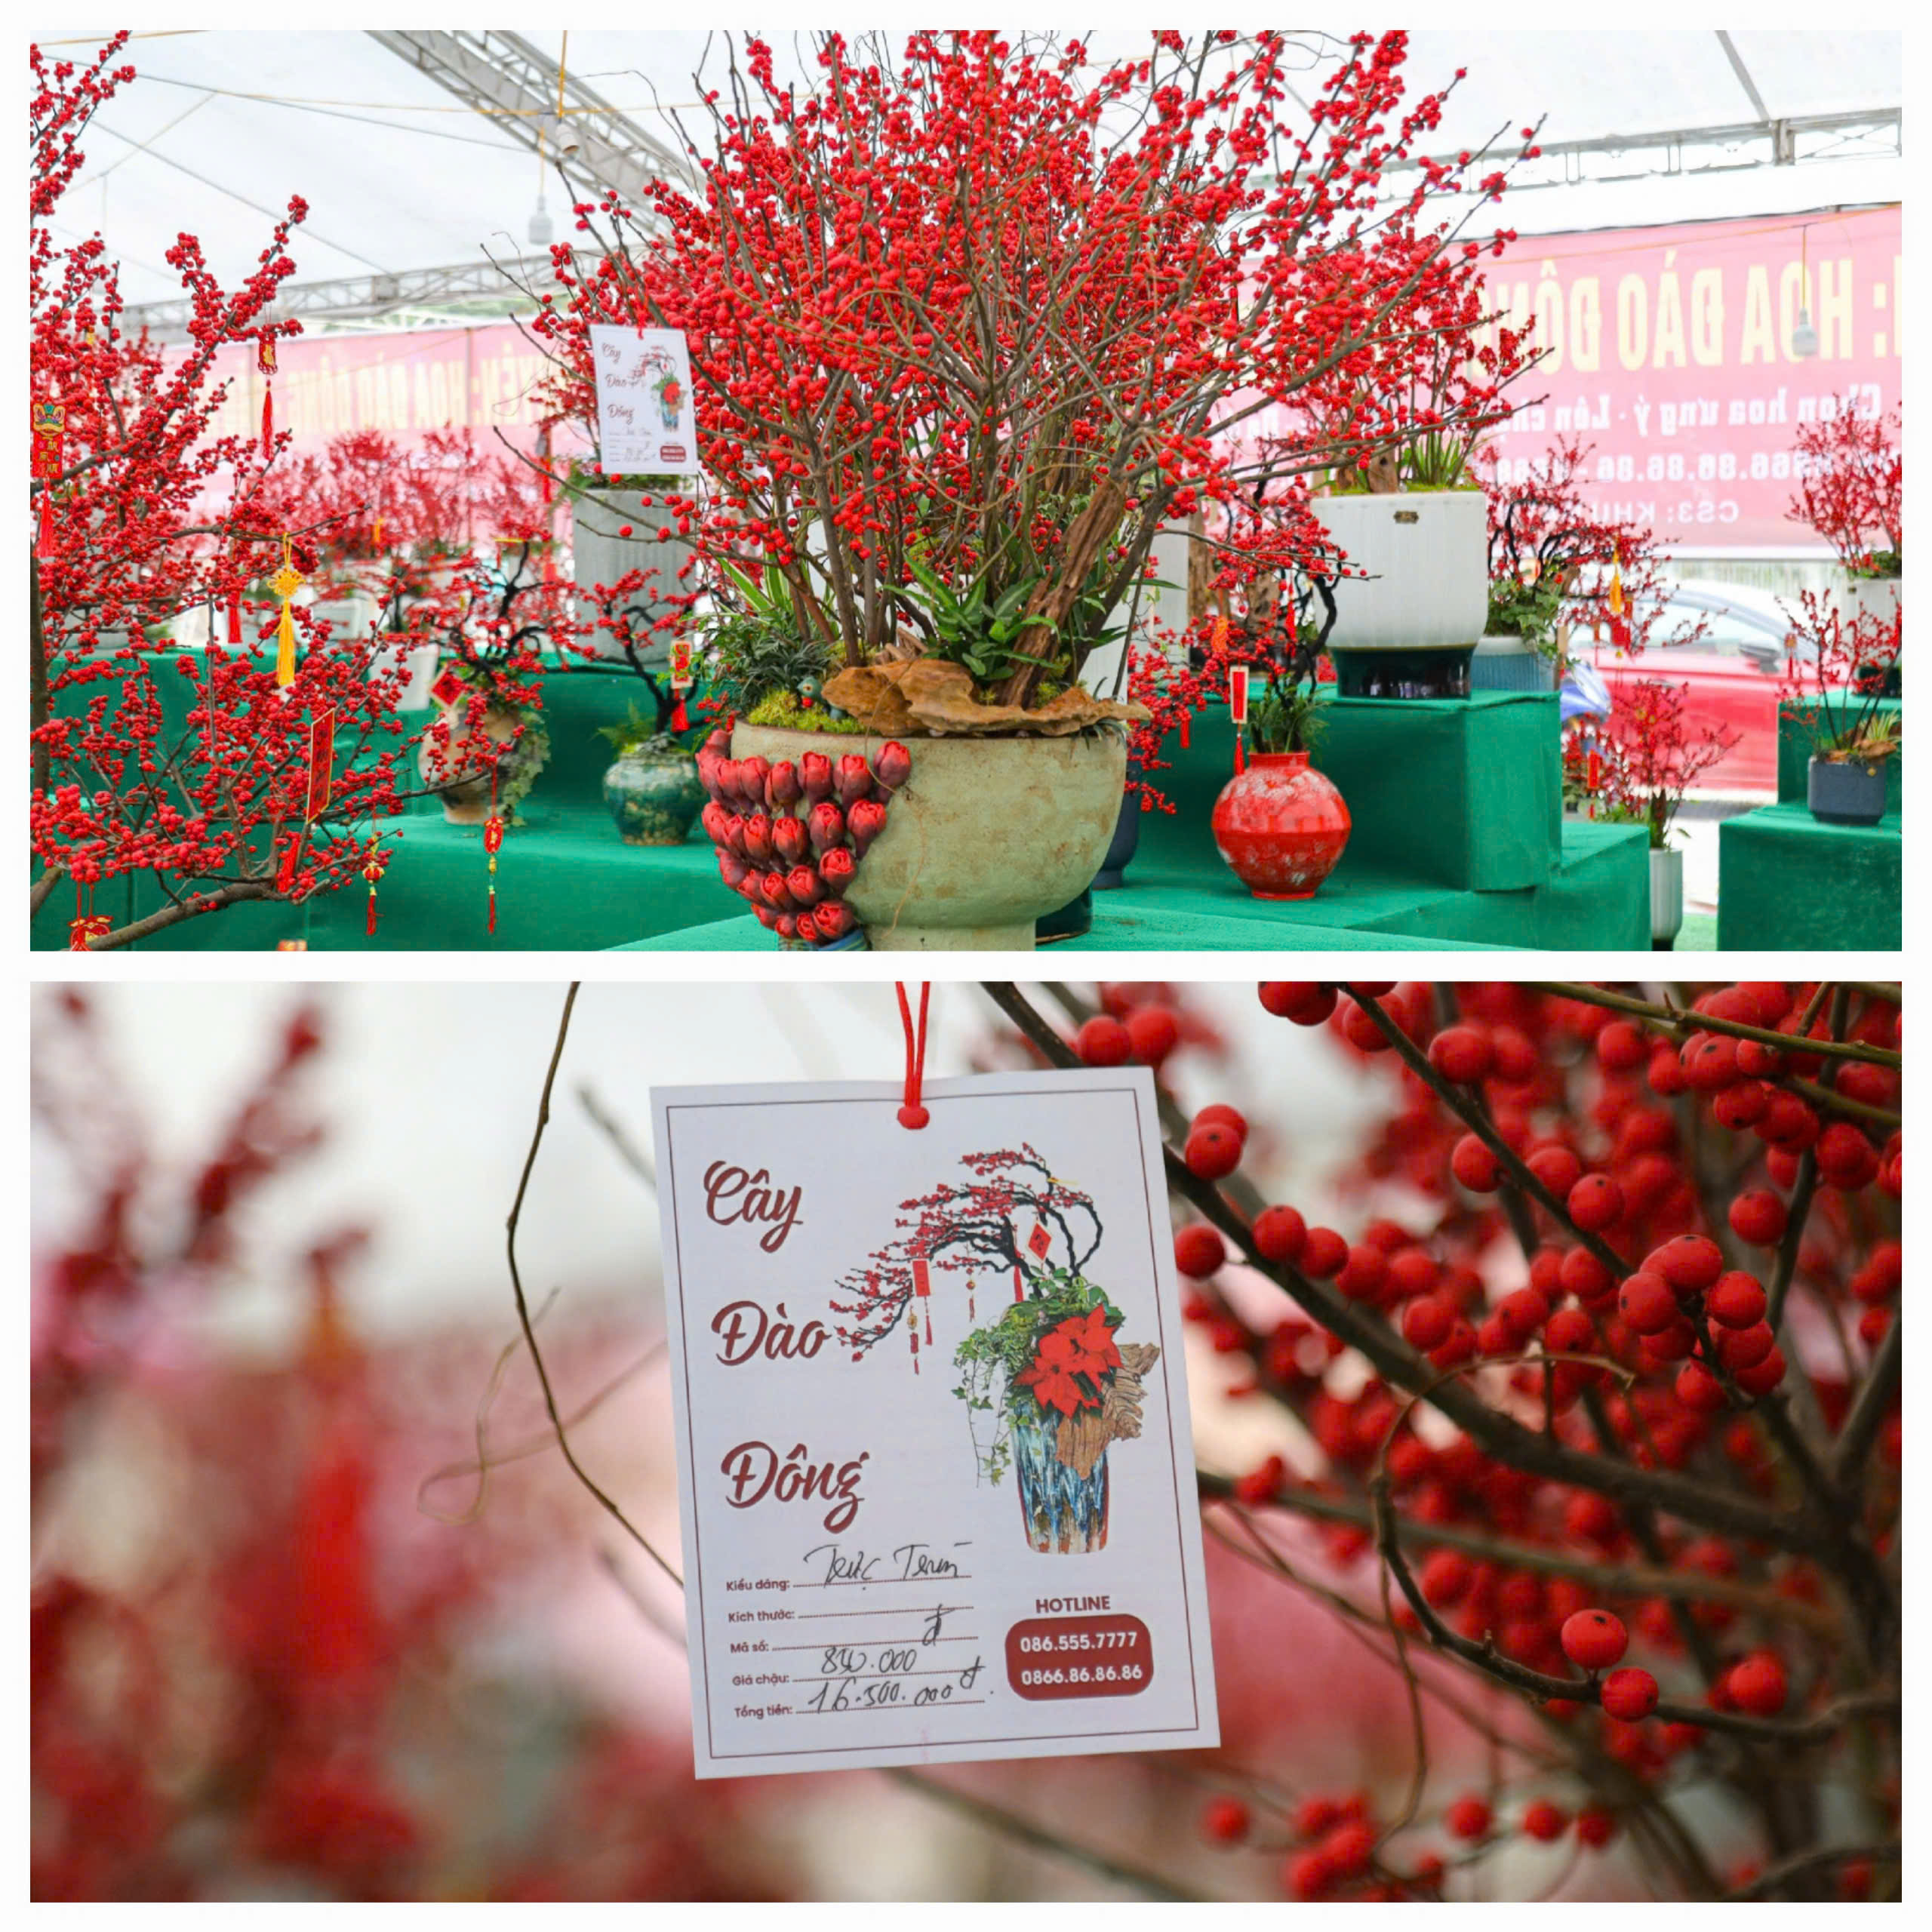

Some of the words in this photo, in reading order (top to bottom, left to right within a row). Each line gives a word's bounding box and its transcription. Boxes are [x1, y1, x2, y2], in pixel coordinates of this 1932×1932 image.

[703, 1161, 804, 1254] Cây
[711, 1300, 832, 1367] Đào
[720, 1440, 870, 1534] Đông
[755, 1578, 791, 1592] dáng:
[1035, 1595, 1111, 1614] HOTLINE
[756, 1608, 795, 1622] thước:
[730, 1641, 749, 1654] Mã
[752, 1639, 770, 1652] số:
[1020, 1630, 1138, 1653] 086.555.7777
[731, 1673, 753, 1686] Giá
[755, 1672, 790, 1687] chậu:
[1021, 1663, 1143, 1687] 0866.86.86.86
[734, 1704, 764, 1721] Tổng
[766, 1703, 793, 1716] tiền:
